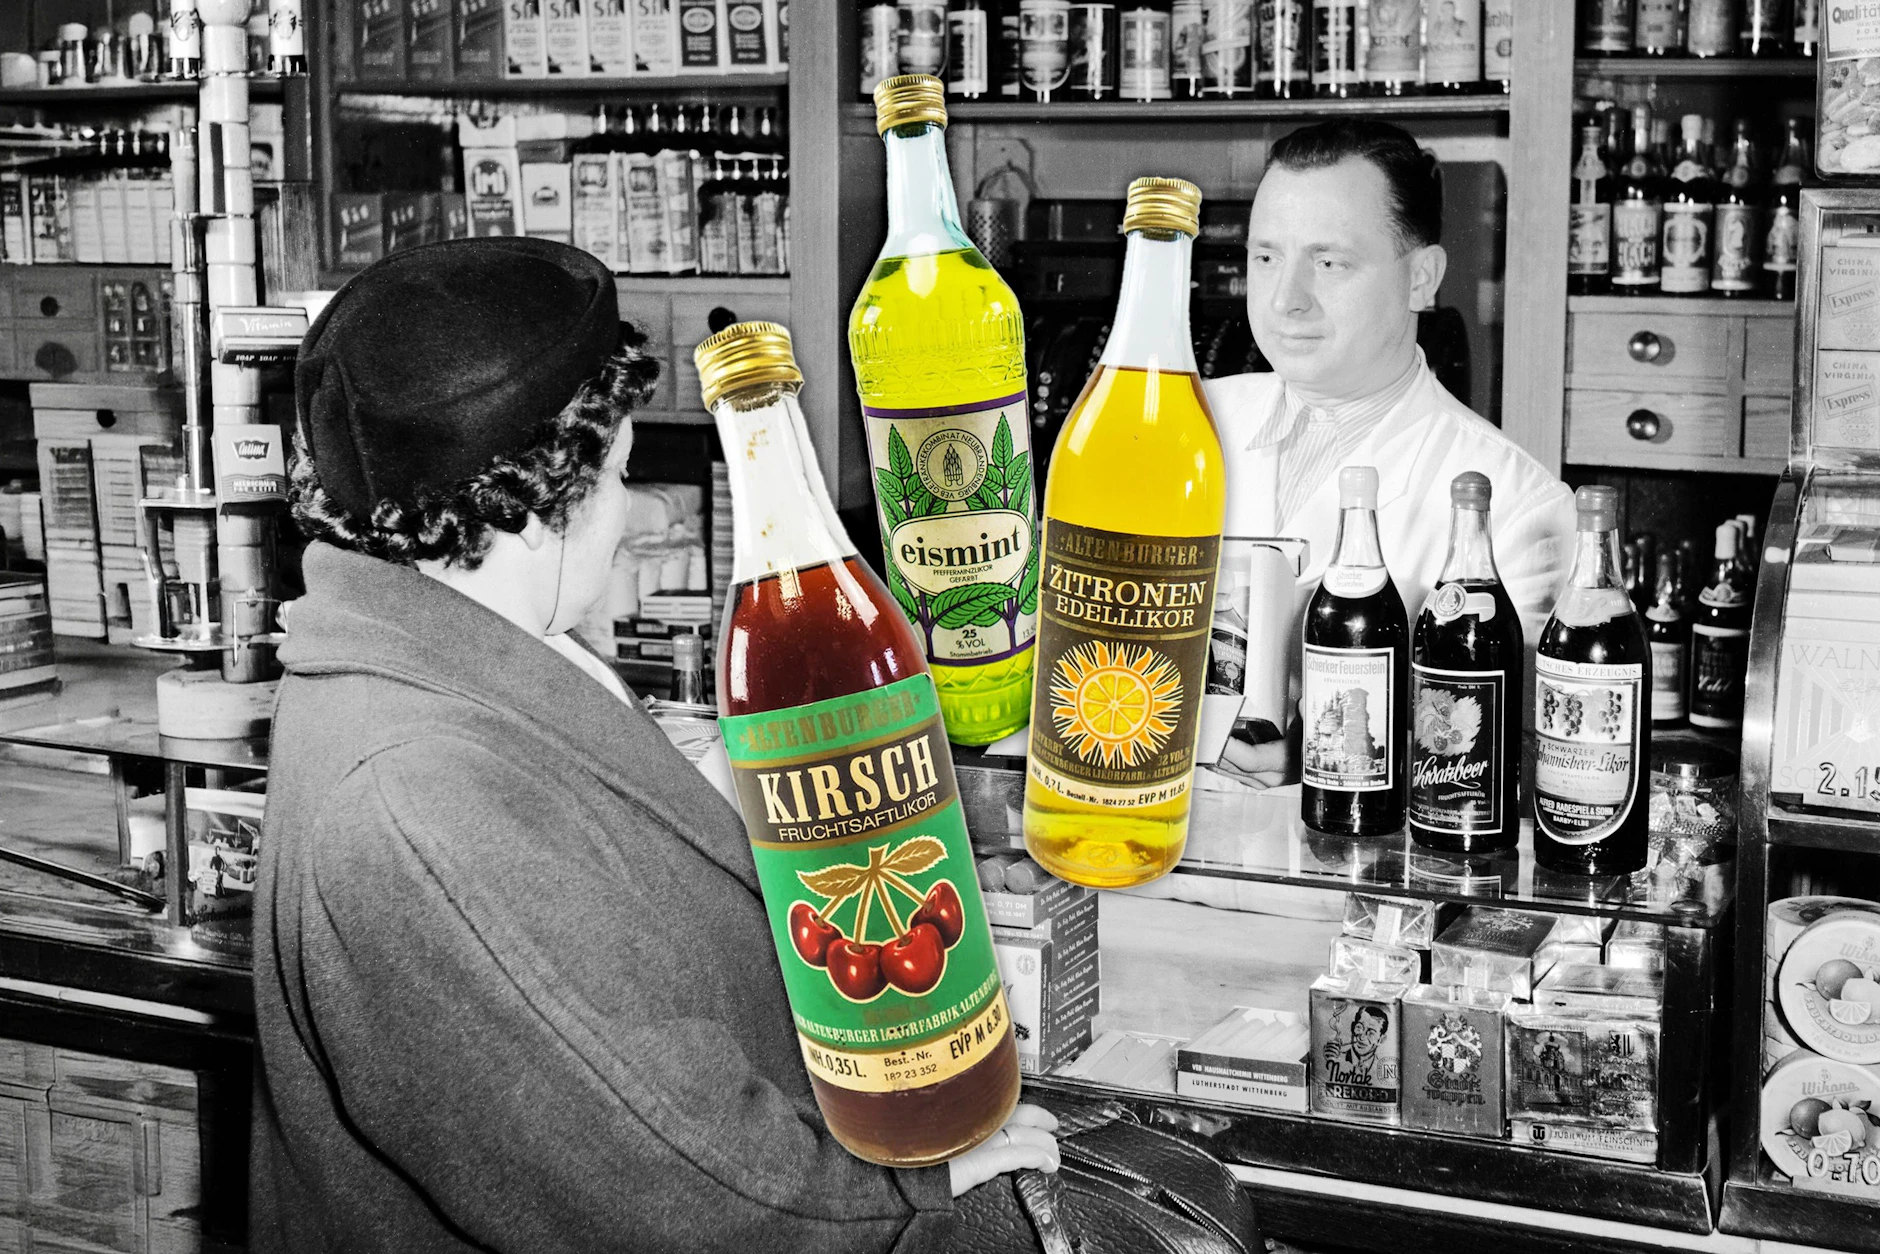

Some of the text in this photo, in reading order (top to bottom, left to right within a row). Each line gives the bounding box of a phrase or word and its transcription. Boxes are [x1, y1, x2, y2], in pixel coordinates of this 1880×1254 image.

[1833, 3, 1880, 24] Qualitä
[1831, 288, 1876, 308] Express
[239, 317, 293, 332] Vitamin
[235, 354, 255, 362] SOAP
[1832, 361, 1868, 370] CHINA
[1824, 371, 1876, 380] VIRGINIA
[1826, 390, 1871, 410] Express
[940, 490, 955, 499] VEB
[957, 433, 985, 498] NEUBRANDENBURG
[901, 524, 1021, 568] eismint
[1065, 531, 1199, 567] ALTENBURGER
[1049, 564, 1208, 608] ZITRONEN
[1055, 593, 1195, 629] EDELLIKÖR
[962, 629, 978, 639] 25
[949, 648, 994, 658] Stammbetrieb
[955, 638, 986, 650] % VOL
[1307, 656, 1386, 675] Schierker Feuerstein
[1577, 666, 1637, 677] ERZEUGNIS
[747, 689, 917, 752] ALTENBURGER
[1547, 742, 1596, 757] SCHWARZER
[757, 735, 939, 824] KIRSCH
[1138, 792, 1157, 806] EVP
[1158, 788, 1168, 800] M
[777, 791, 937, 842] FRUCHTSAFTLIKÖR
[1015, 902, 1027, 910] DM
[807, 1018, 879, 1043] ALTENBURGER
[949, 1031, 972, 1060] EVP
[974, 1023, 986, 1046] M
[904, 1068, 918, 1080] 23
[919, 1063, 938, 1077] 352
[1191, 1063, 1289, 1084] VEB HAUSHALTCHEMIE WITTENBERG
[1325, 1059, 1373, 1086] Nortak
[1383, 1064, 1397, 1079] N
[1192, 1079, 1288, 1097] LUTHERSTADT WITTENBERG
[1801, 1082, 1861, 1098] Wikana
